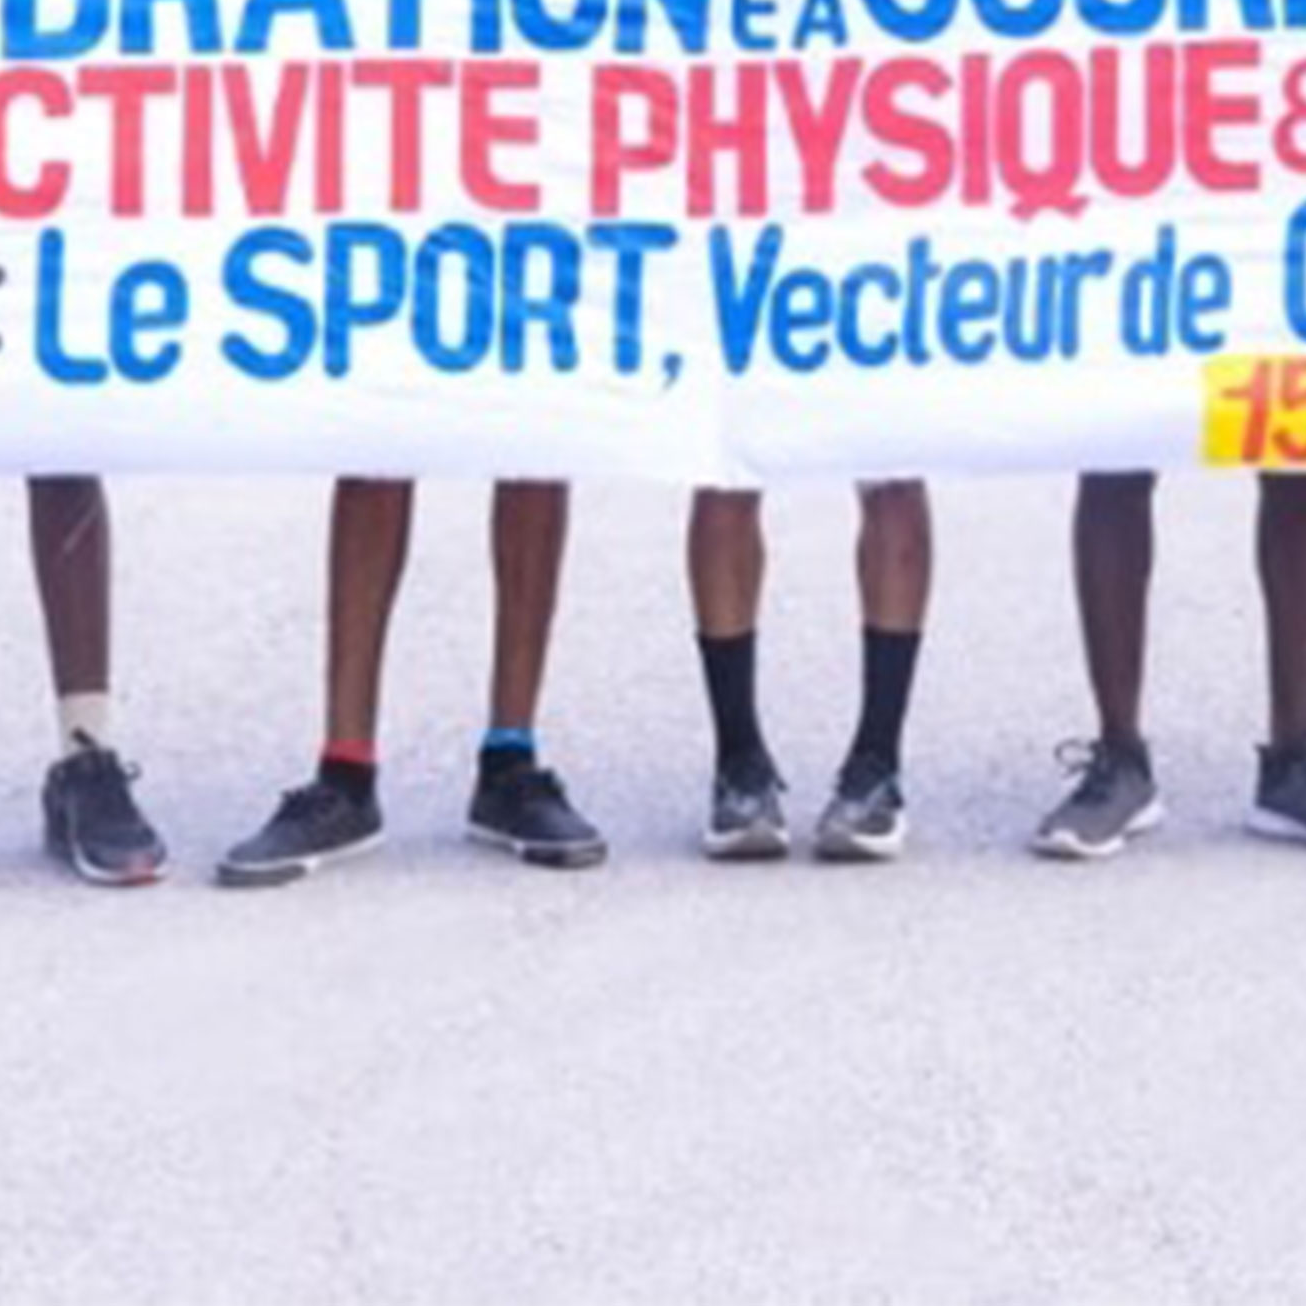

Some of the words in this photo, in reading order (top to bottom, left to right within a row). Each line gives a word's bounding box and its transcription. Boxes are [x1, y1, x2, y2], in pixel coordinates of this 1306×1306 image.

[591, 40, 1262, 222] PHYSIQUE
[35, 229, 190, 386] Le
[708, 226, 1096, 375] Vecteur
[1120, 228, 1231, 355] de
